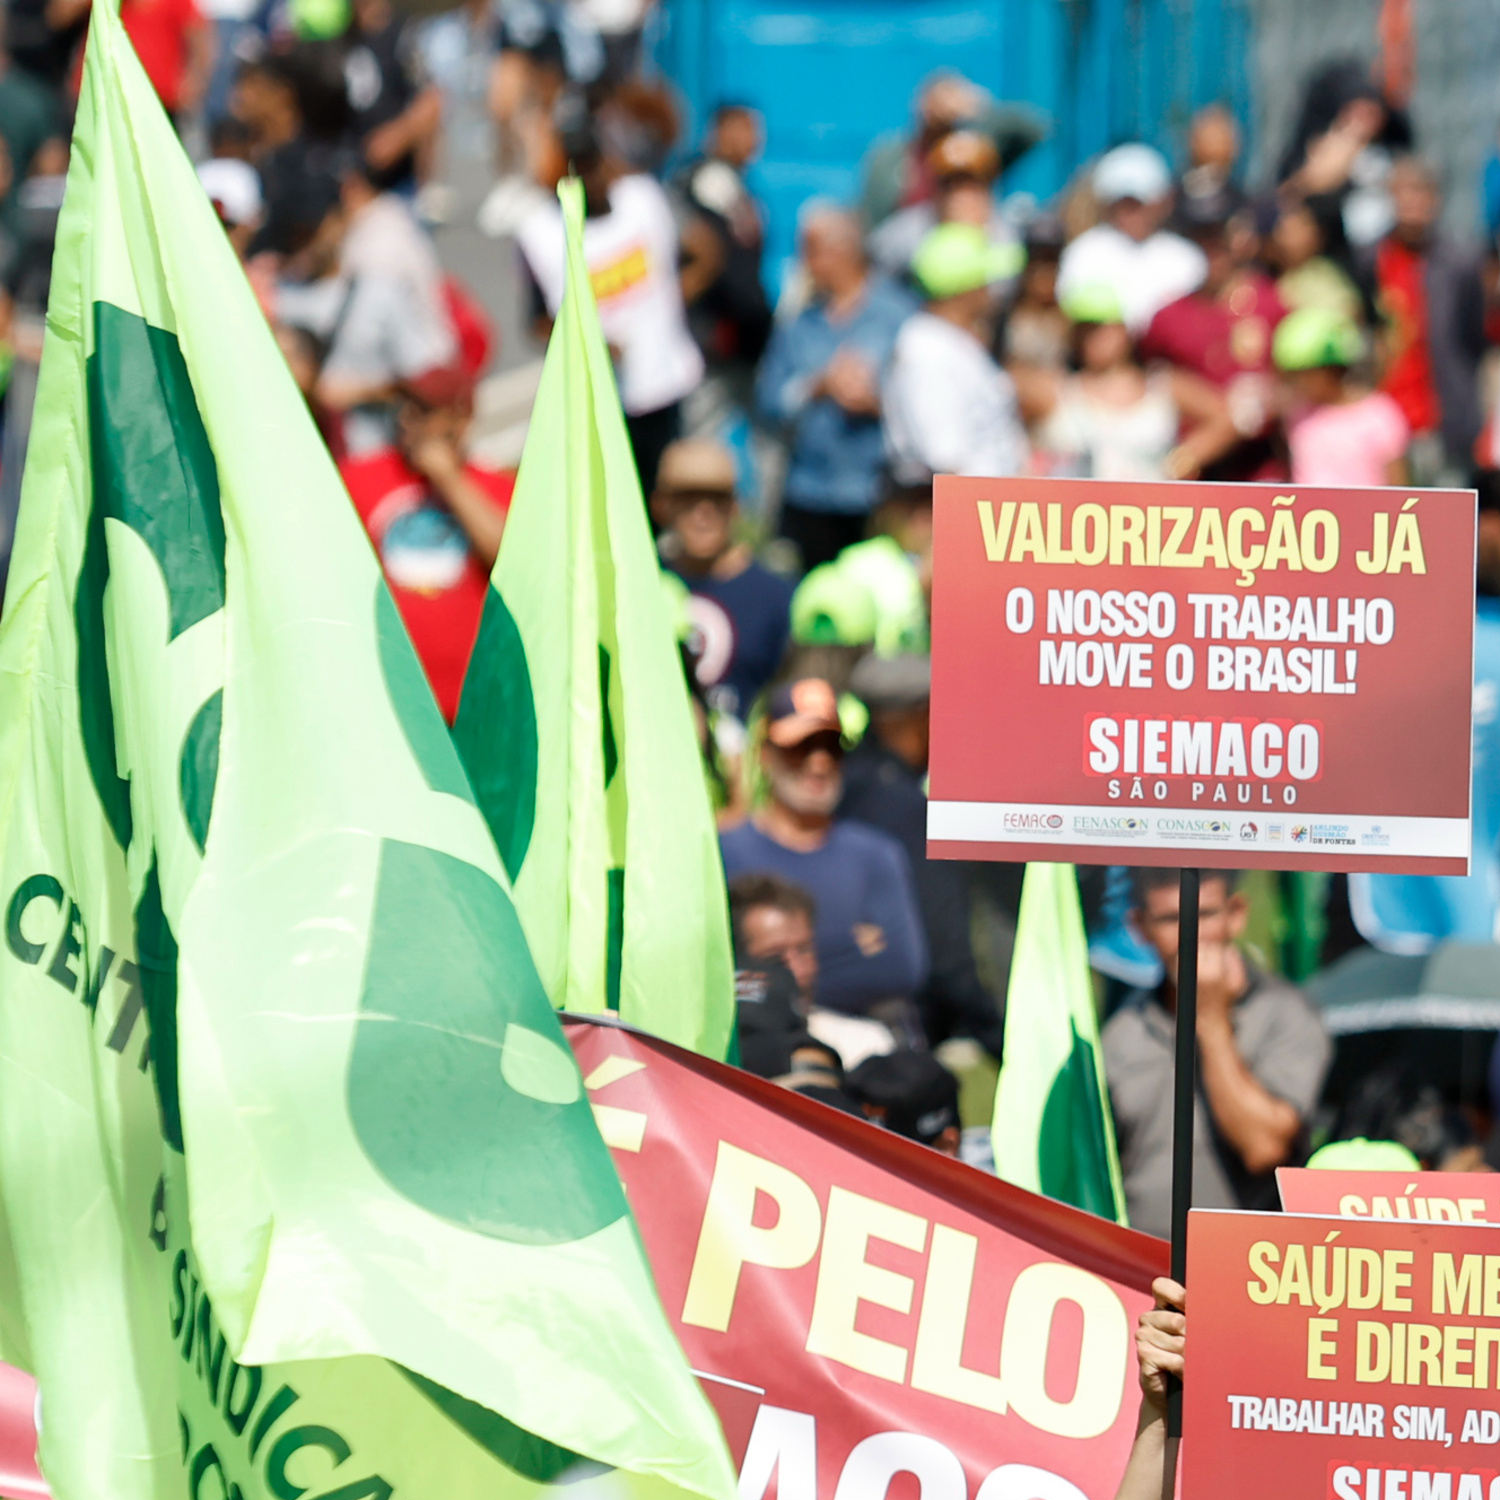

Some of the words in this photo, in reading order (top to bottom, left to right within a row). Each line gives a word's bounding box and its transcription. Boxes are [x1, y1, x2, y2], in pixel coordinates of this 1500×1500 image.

[976, 494, 1340, 587] VALORIZAÇÃO
[1355, 498, 1427, 575] JÁ
[1004, 587, 1034, 634] O
[1046, 589, 1176, 639] NOSSO
[1187, 594, 1395, 645] TRABALHO
[1038, 640, 1153, 689] MOVE
[1165, 644, 1195, 690] O
[1207, 646, 1358, 695] BRASIL!
[1088, 717, 1320, 781] SIEMACO
[1107, 777, 1168, 801] SÃO
[1192, 781, 1298, 805] PAULO
[1003, 812, 1063, 829] FEMACO
[1073, 816, 1149, 830] FENASCON
[1156, 819, 1232, 832] CONASCON
[680, 1139, 1129, 1440] PELO
[1246, 1231, 1413, 1313] SAÚDE
[1227, 1395, 1385, 1439] TRABALHAR
[1392, 1404, 1453, 1448] SIM,
